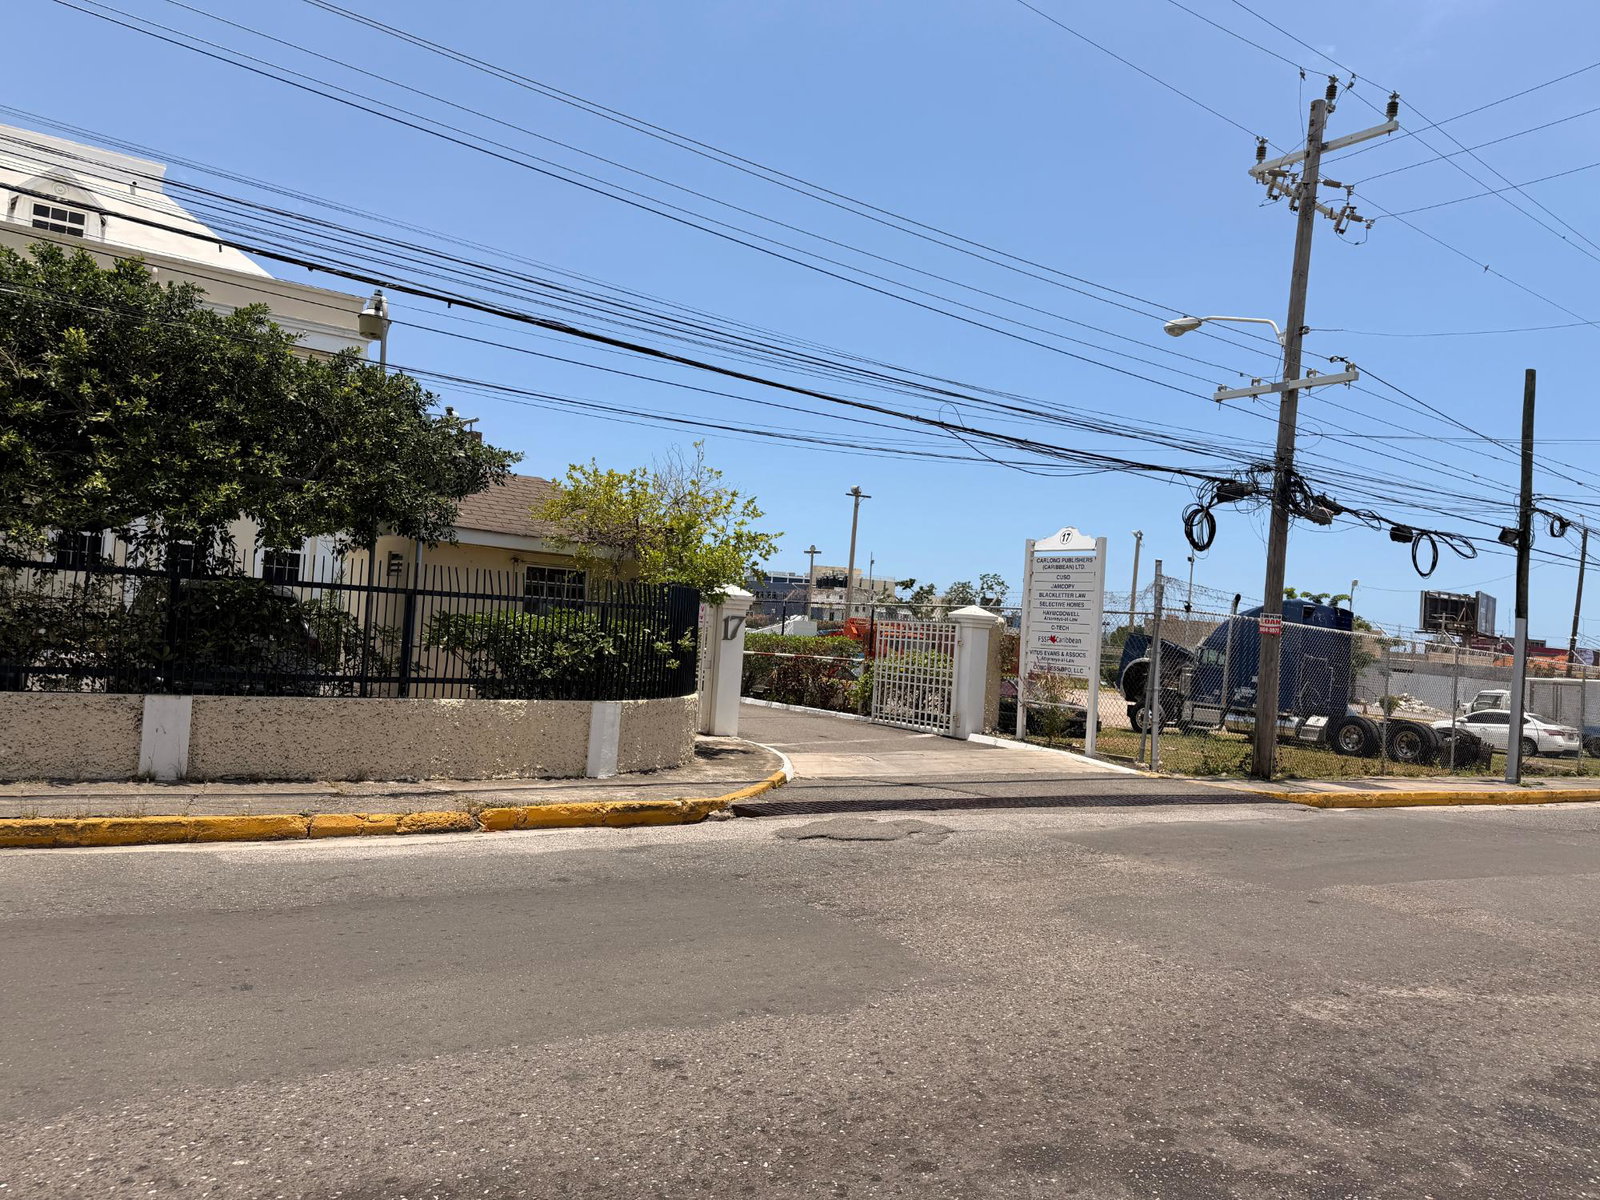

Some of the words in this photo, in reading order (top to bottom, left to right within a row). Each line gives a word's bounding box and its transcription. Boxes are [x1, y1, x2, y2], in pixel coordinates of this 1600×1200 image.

[1062, 533, 1071, 542] 17
[722, 615, 747, 641] 17
[1056, 636, 1082, 644] Caribbean
